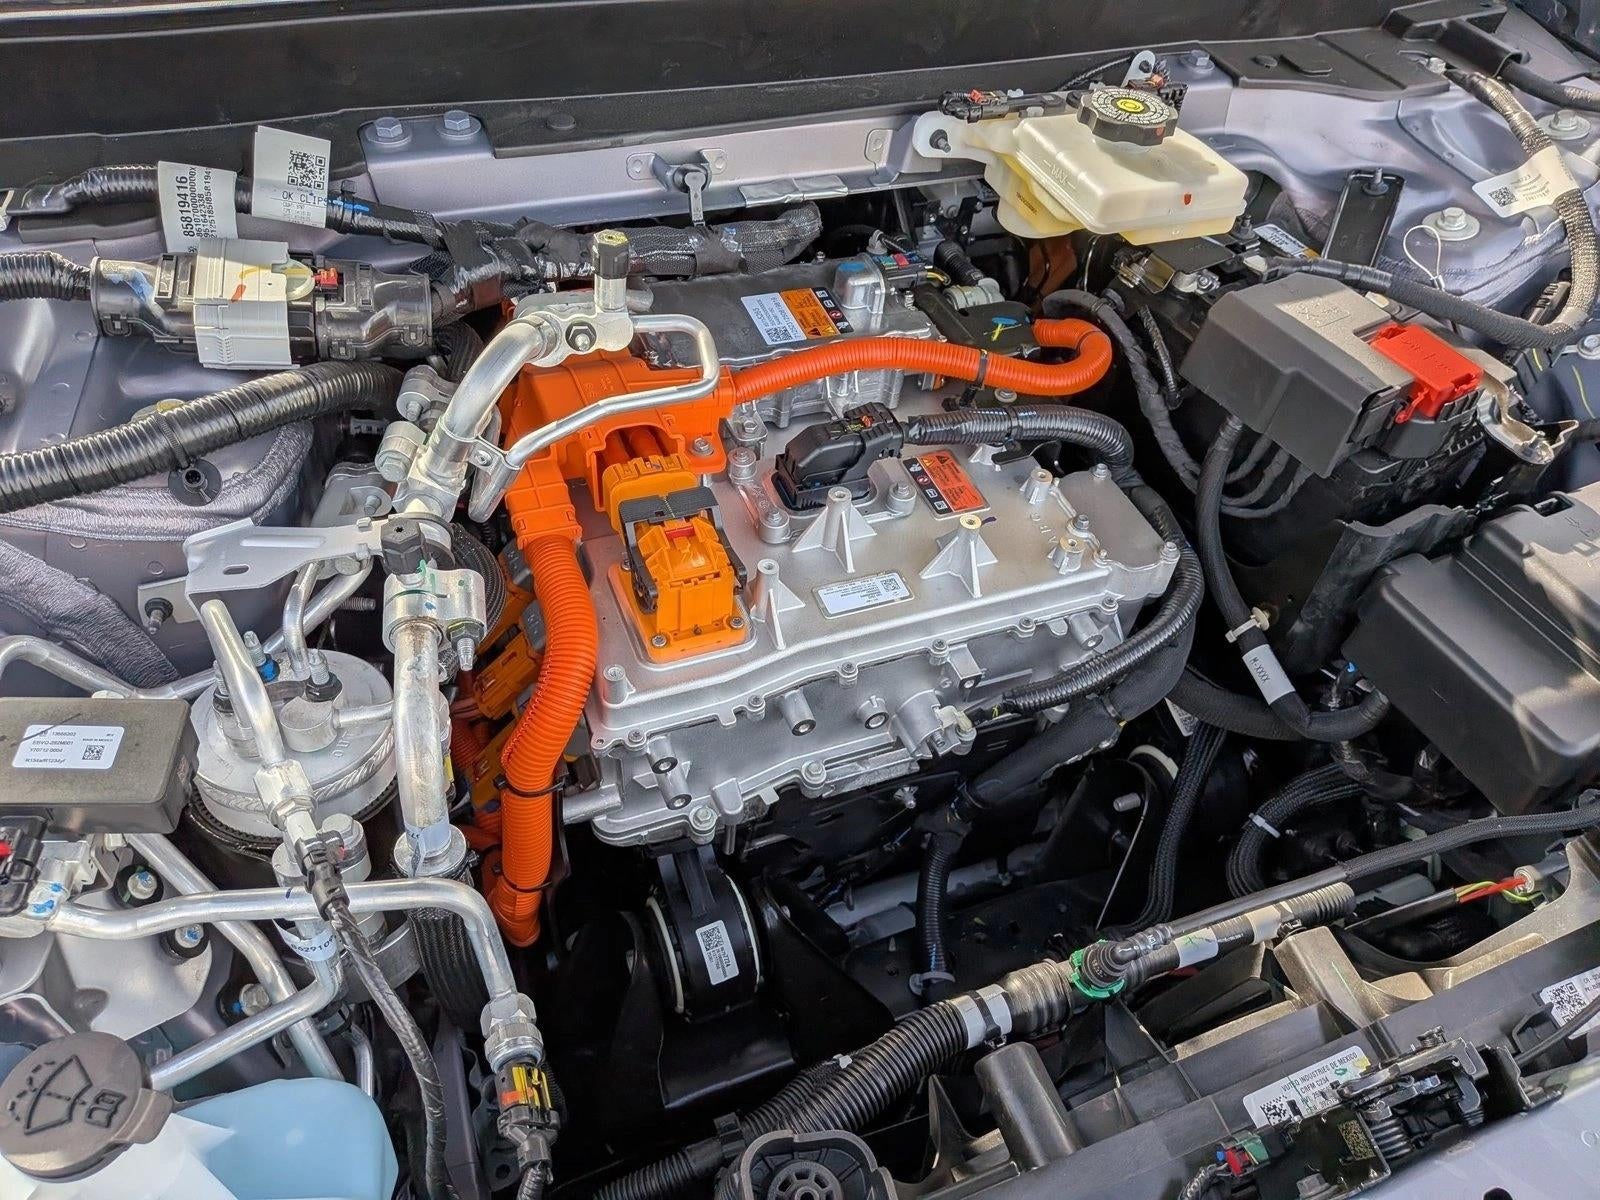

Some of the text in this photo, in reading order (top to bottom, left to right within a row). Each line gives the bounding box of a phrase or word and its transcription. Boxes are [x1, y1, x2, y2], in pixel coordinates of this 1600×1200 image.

[176, 175, 195, 237] 85819416
[282, 190, 329, 206] OK CLIPS
[1299, 1065, 1331, 1086] INDUSTRIES
[1330, 1060, 1339, 1070] DE
[1338, 1052, 1359, 1065] MEXICO
